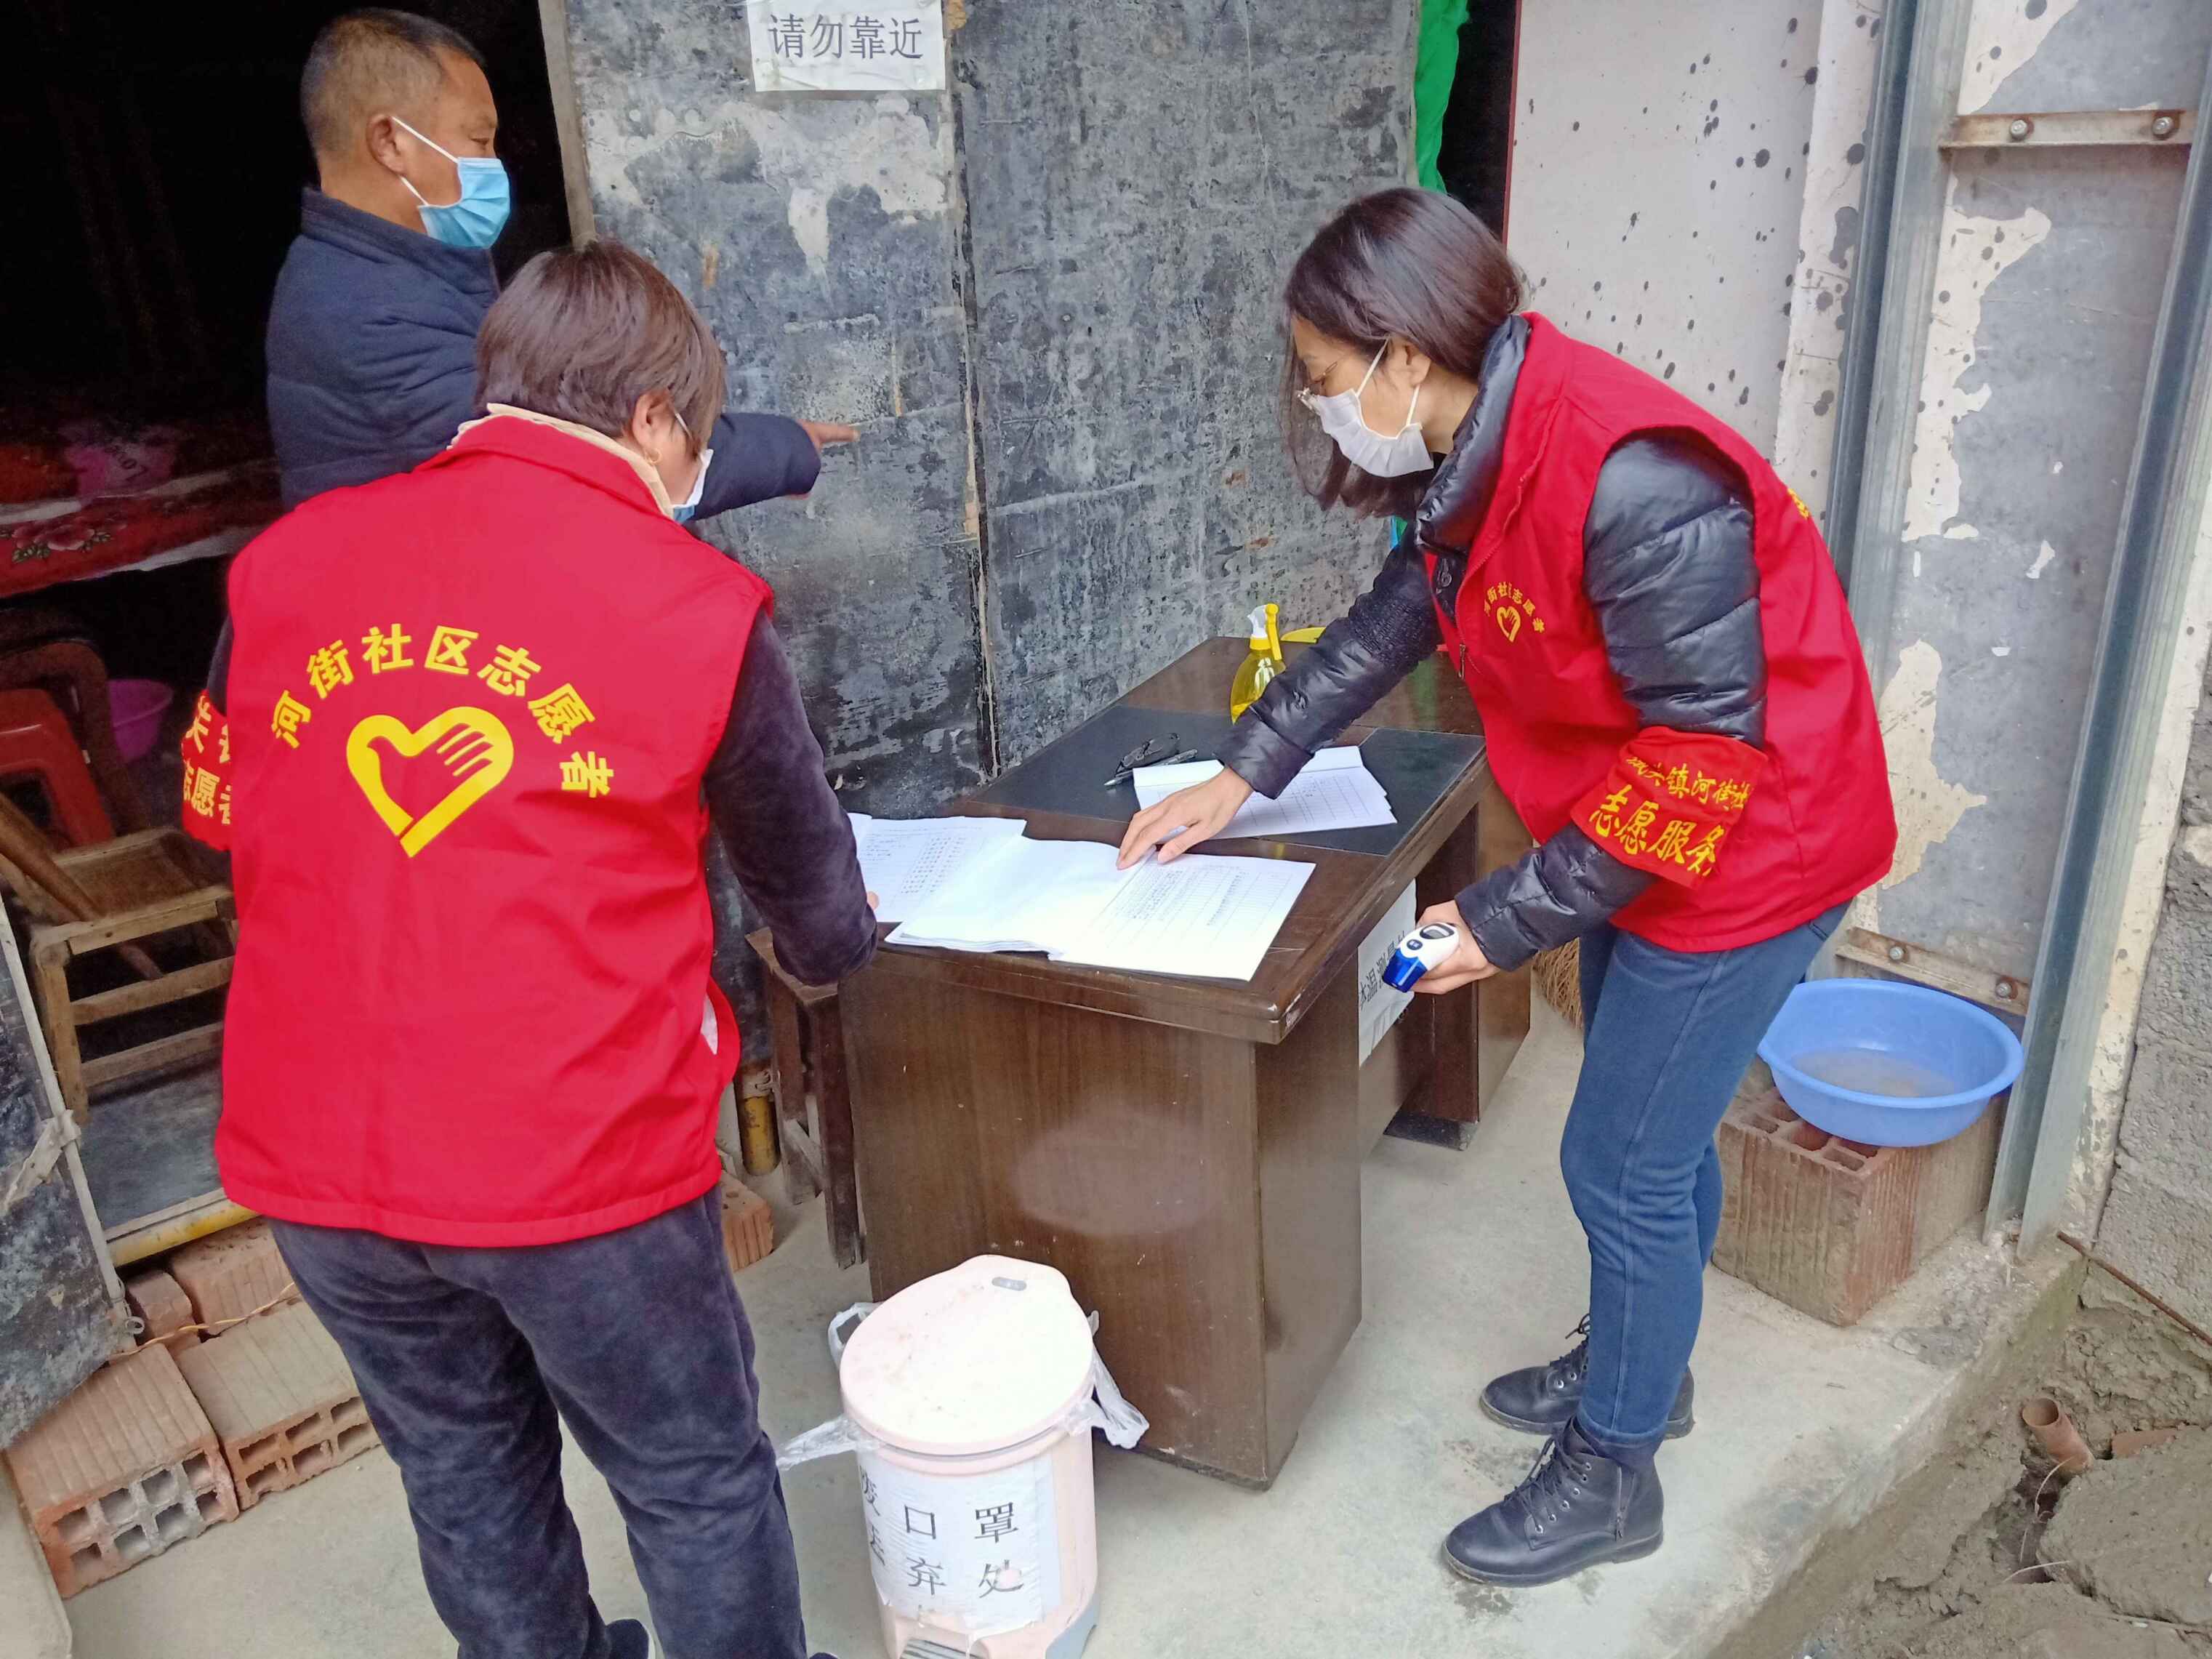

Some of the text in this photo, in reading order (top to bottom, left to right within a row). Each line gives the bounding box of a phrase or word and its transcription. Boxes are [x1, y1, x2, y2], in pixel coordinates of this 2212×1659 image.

[768, 13, 924, 60] 请勿靠近
[271, 623, 614, 798] 河街社区志愿者
[1589, 784, 1725, 876] 志愿服务
